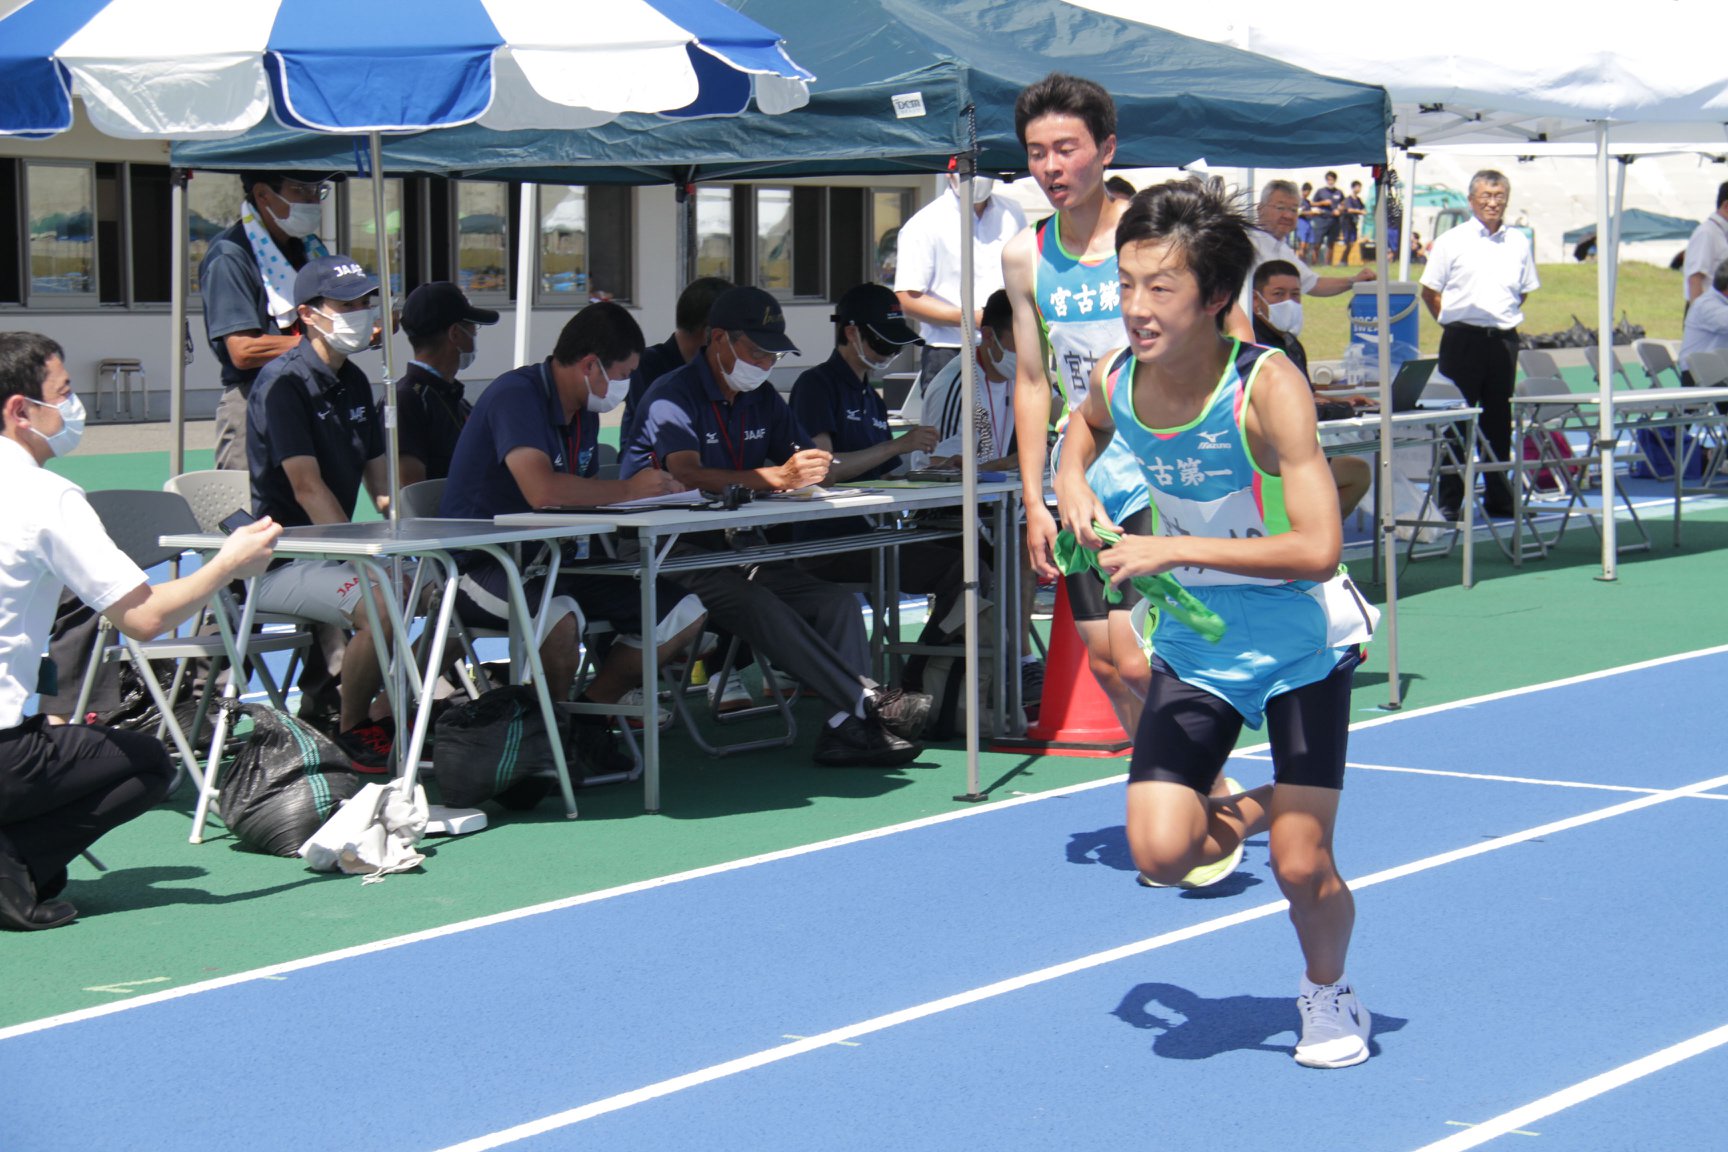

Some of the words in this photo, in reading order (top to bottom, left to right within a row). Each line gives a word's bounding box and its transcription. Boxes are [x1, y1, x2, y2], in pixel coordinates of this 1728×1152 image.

[1050, 281, 1120, 317] 宮古第
[744, 428, 766, 440] JAAF
[1136, 456, 1233, 486] 古第一
[337, 577, 359, 597] JAA
